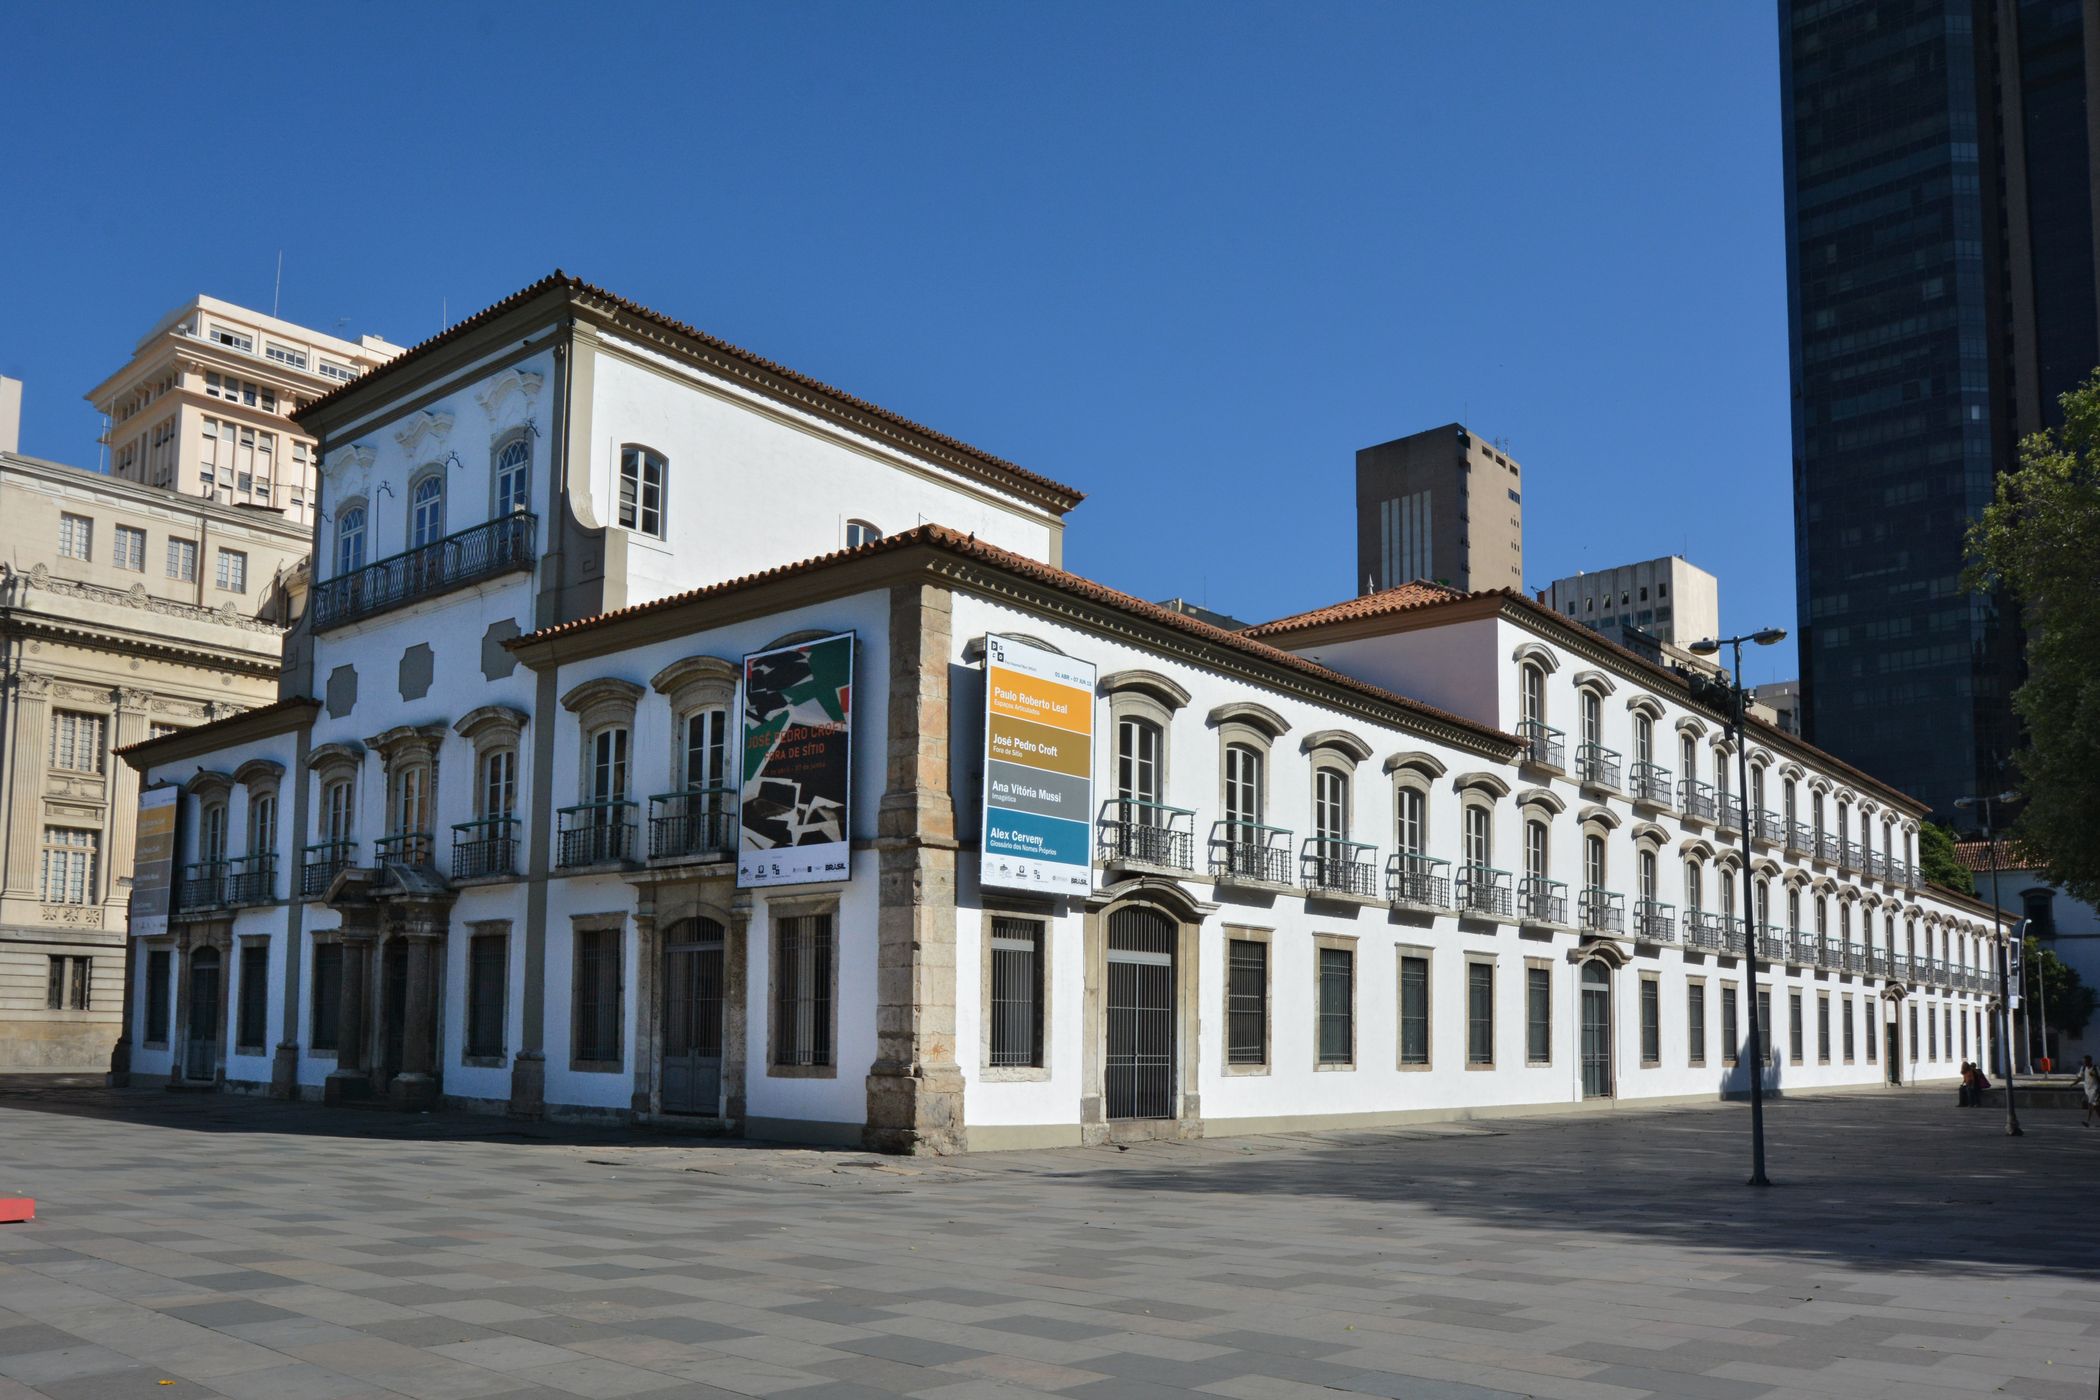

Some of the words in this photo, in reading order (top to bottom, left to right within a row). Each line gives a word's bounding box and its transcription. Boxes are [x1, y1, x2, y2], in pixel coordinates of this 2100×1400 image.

[994, 687, 1016, 701] Paulo
[1019, 693, 1050, 709] Roberto
[1052, 701, 1068, 714] Leal
[748, 732, 770, 748] JOSÉ
[774, 727, 807, 744] PEDRO
[811, 720, 844, 738] CROFT
[765, 750, 786, 761] FORA
[789, 747, 800, 758] DE
[802, 742, 824, 756] SÍTIO
[993, 733, 1012, 746] José
[1014, 738, 1036, 752] Pedro
[1038, 744, 1058, 756] Croft
[992, 780, 1008, 792] Ana
[1011, 784, 1036, 798] Vitória
[1038, 789, 1061, 802] Mussi
[992, 793, 1016, 802] Imagética
[990, 827, 1009, 840] Alex
[1012, 830, 1043, 846] Cerveny
[990, 840, 1012, 849] Glossário
[1022, 844, 1038, 852] Nomes
[1038, 846, 1056, 856] Próprios
